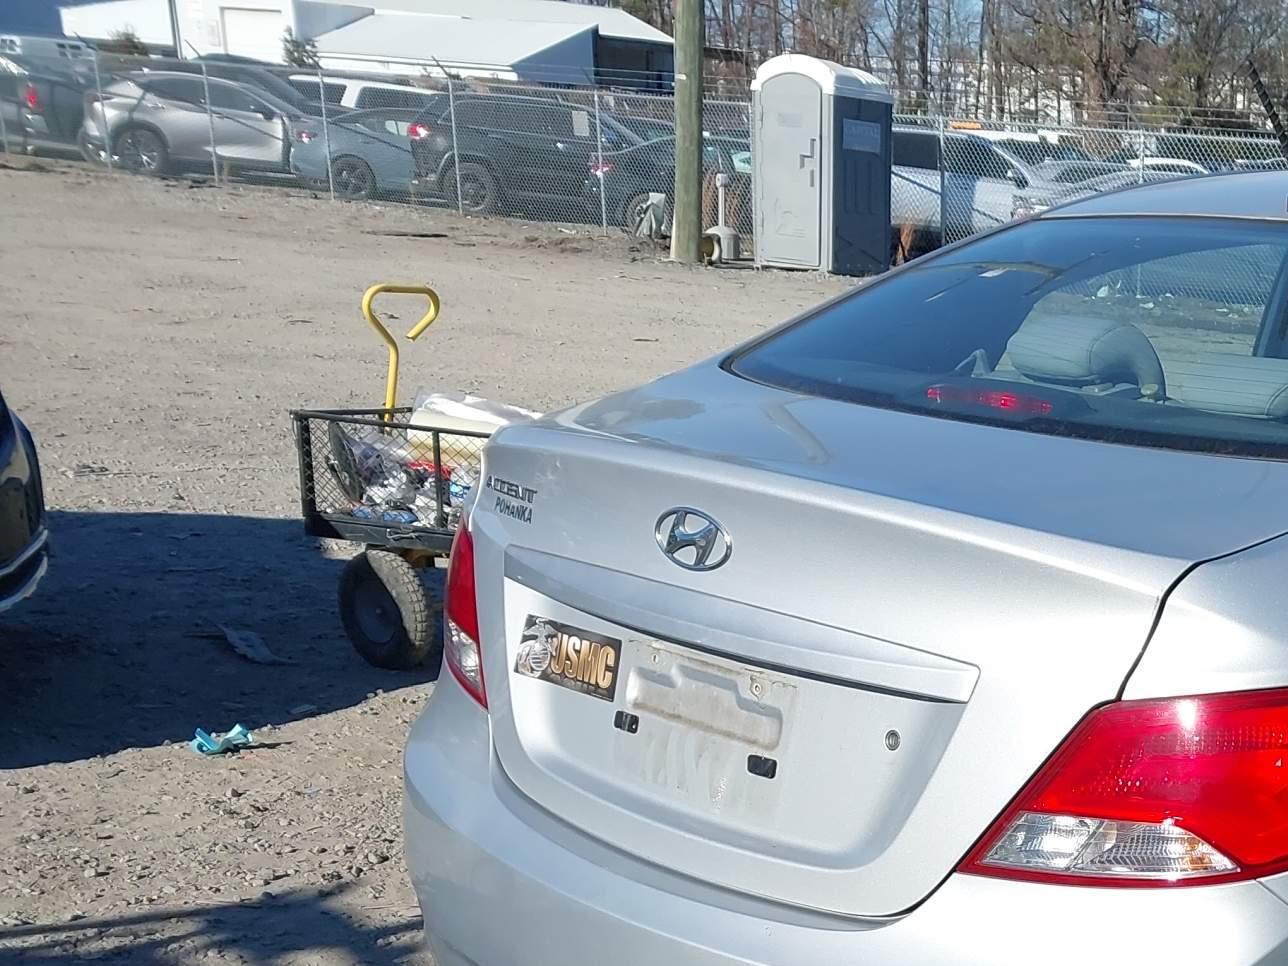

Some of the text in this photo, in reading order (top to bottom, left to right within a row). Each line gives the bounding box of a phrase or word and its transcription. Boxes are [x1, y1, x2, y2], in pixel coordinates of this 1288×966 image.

[486, 475, 538, 504] ACCENT
[494, 496, 533, 525] POHANKA
[549, 631, 616, 689] USMC
